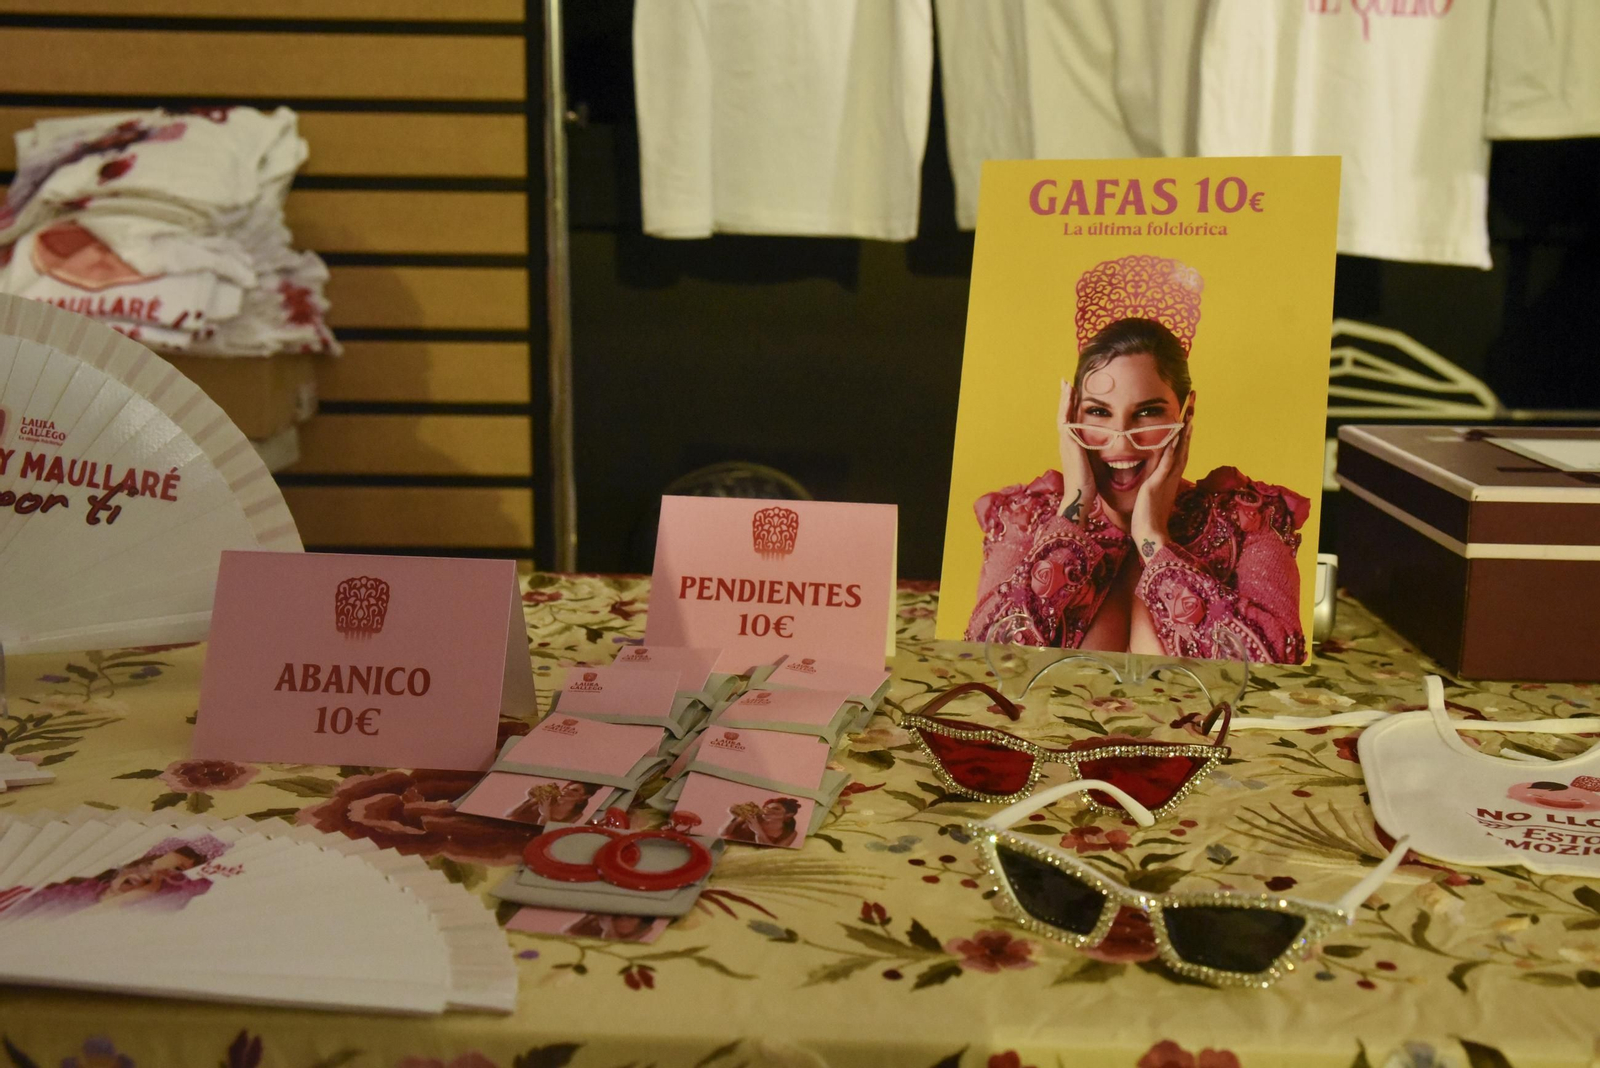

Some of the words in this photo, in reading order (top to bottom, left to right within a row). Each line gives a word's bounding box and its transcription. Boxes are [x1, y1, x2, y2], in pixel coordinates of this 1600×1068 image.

[1029, 178, 1178, 216] GAFAS
[1194, 176, 1265, 214] 10€
[1063, 222, 1083, 236] La
[1088, 222, 1142, 236] última
[1147, 222, 1228, 236] folclórica
[35, 296, 162, 324] AULLARÉ
[20, 426, 66, 441] GALLEGO
[20, 451, 181, 501] MAULLARÉ
[678, 576, 862, 608] PENDIENTES
[737, 613, 795, 638] 10€
[273, 662, 431, 697] ABANICO
[314, 706, 381, 736] 10€
[1477, 808, 1532, 821] NO
